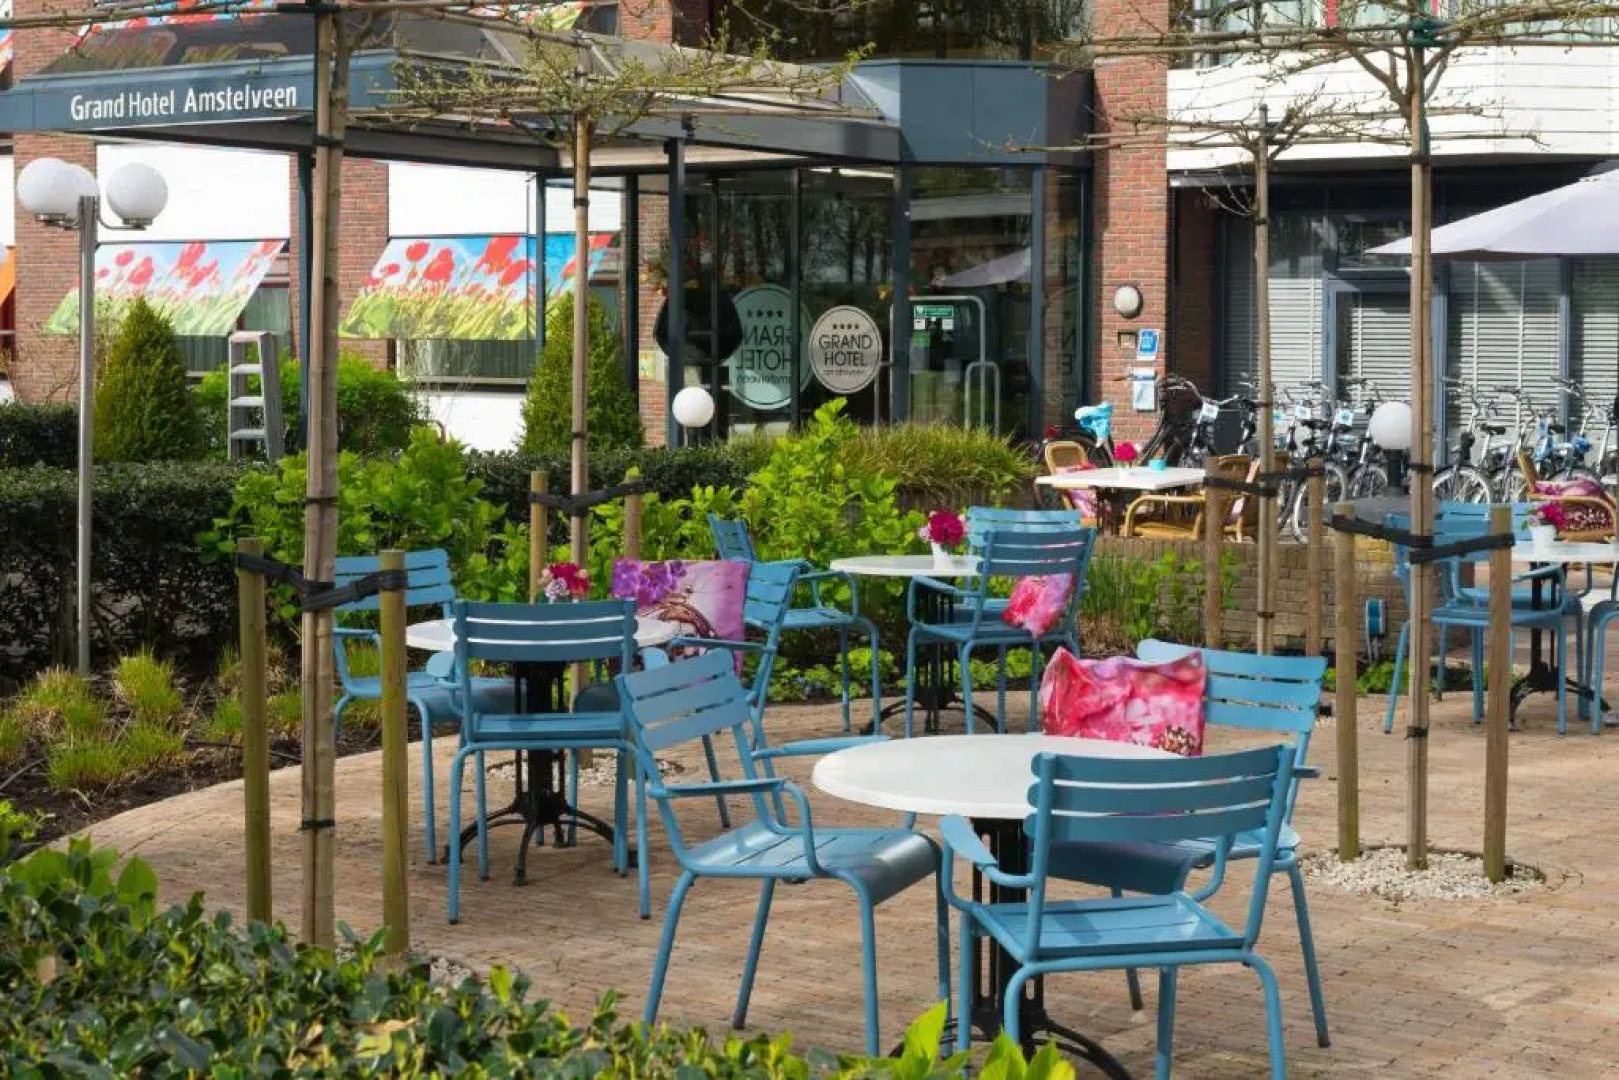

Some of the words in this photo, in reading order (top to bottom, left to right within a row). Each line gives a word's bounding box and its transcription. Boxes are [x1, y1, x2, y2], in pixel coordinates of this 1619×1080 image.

[70, 93, 124, 121] Grand
[129, 90, 175, 117] Hotel
[183, 84, 297, 114] Amstelveen
[818, 334, 873, 350] GRAND
[824, 350, 868, 367] HOTEL
